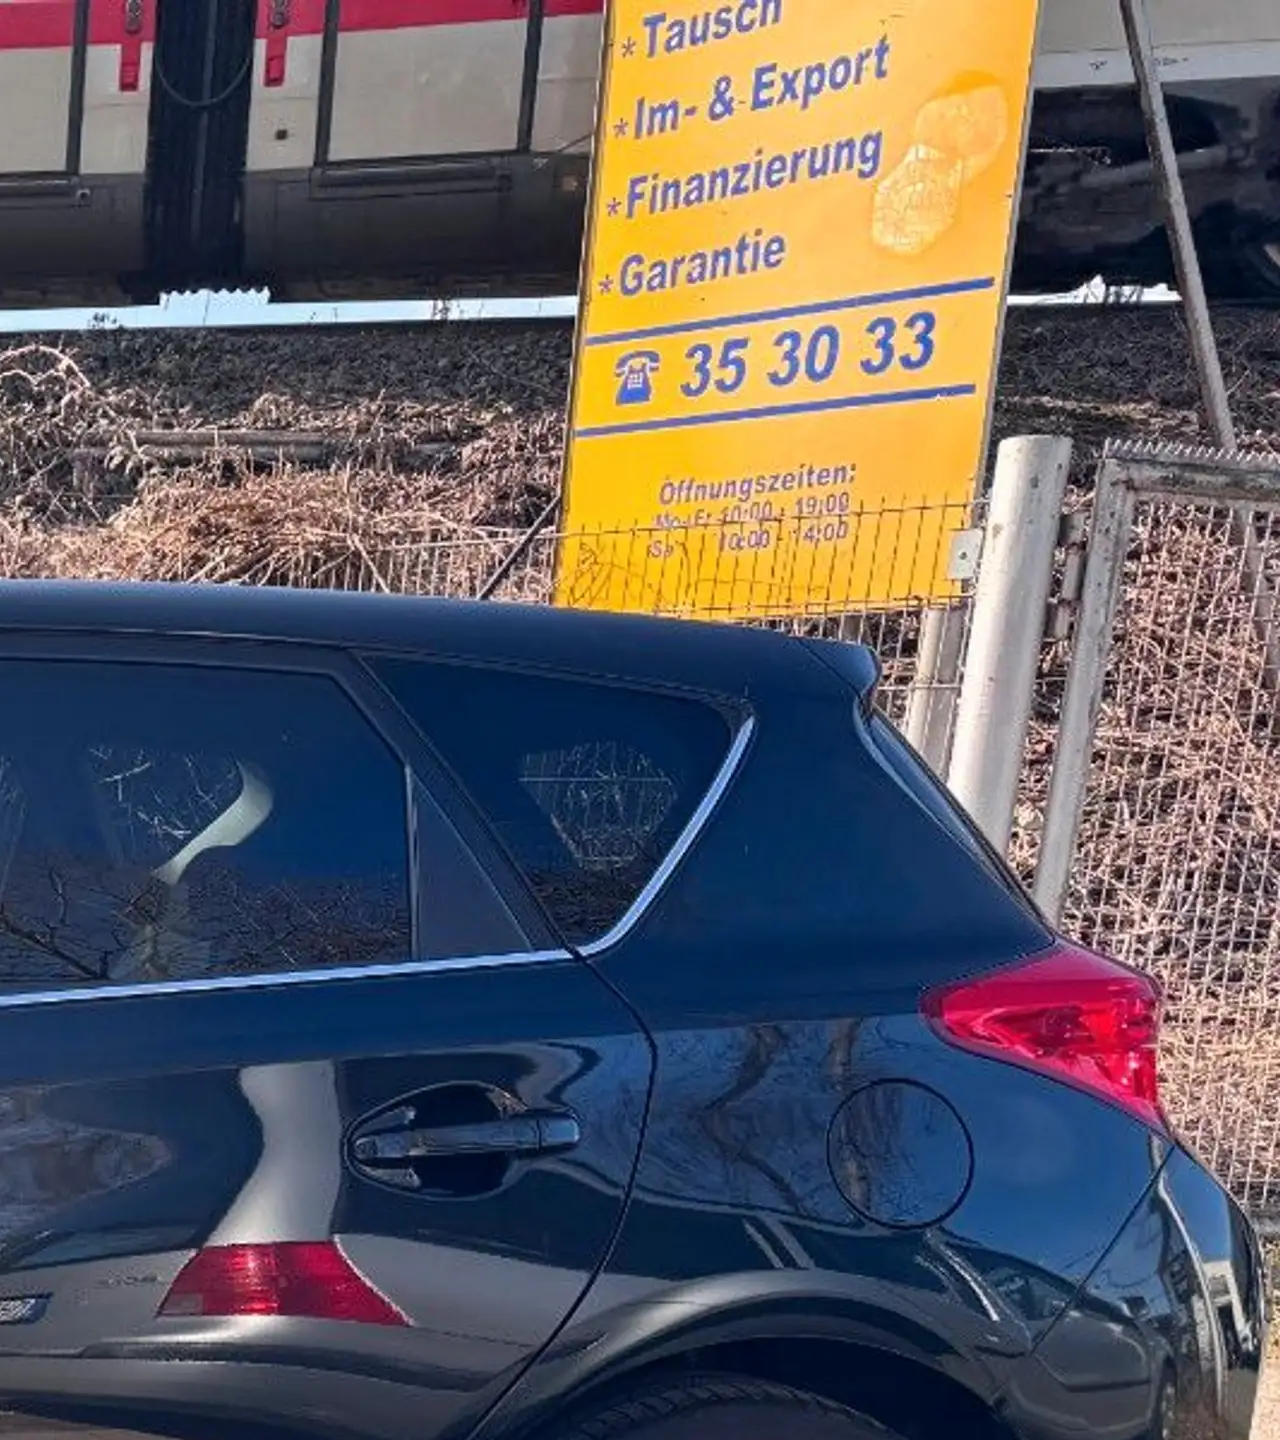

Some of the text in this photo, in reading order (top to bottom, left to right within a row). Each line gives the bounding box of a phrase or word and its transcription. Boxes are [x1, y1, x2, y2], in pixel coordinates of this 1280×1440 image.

[643, 0, 782, 58] Tausch
[708, 74, 735, 122] &
[750, 33, 891, 111] Export
[625, 129, 883, 220] Finanzierung
[620, 228, 786, 296] Garantie
[680, 311, 936, 398] 35 30 33
